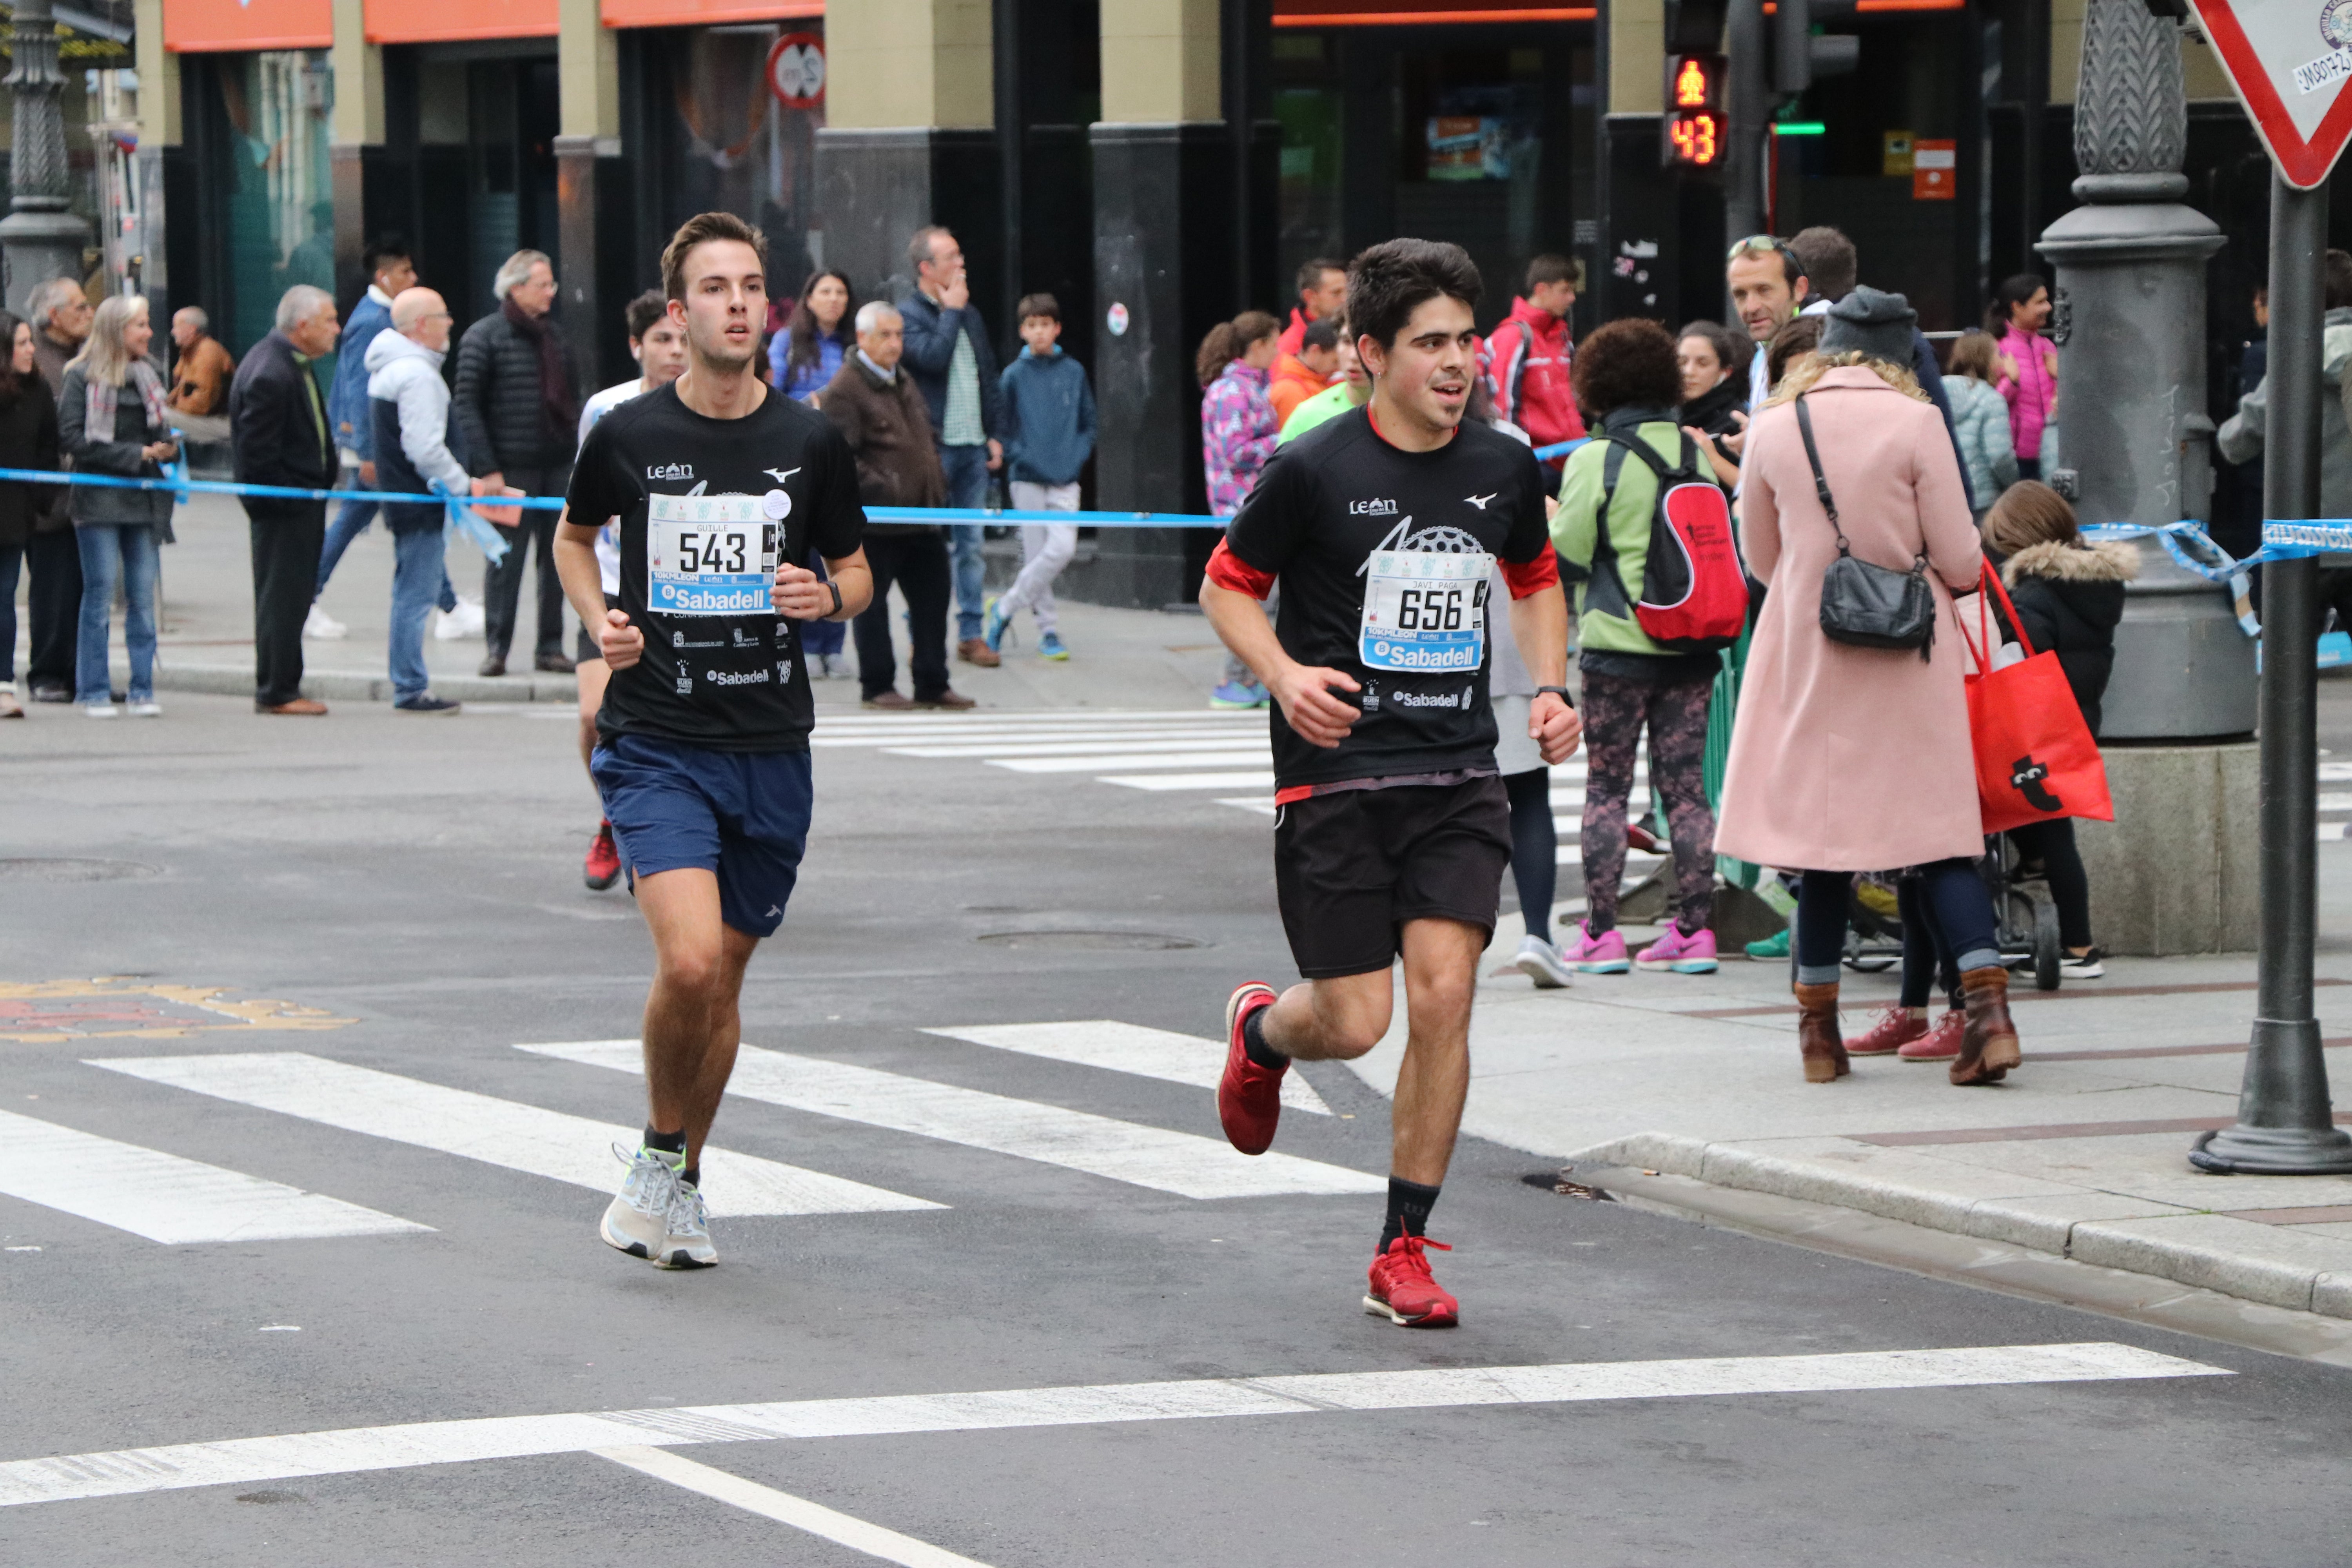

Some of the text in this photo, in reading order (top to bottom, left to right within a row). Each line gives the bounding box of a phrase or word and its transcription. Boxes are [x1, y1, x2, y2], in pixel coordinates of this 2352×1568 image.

[1671, 116, 1715, 163] 43
[681, 534, 745, 572] 543
[676, 589, 764, 609] Sabadell
[1399, 590, 1461, 630] 656
[1389, 646, 1474, 666] Sabadell
[717, 669, 769, 685] Sabadell
[1403, 692, 1458, 707] Sabadell
